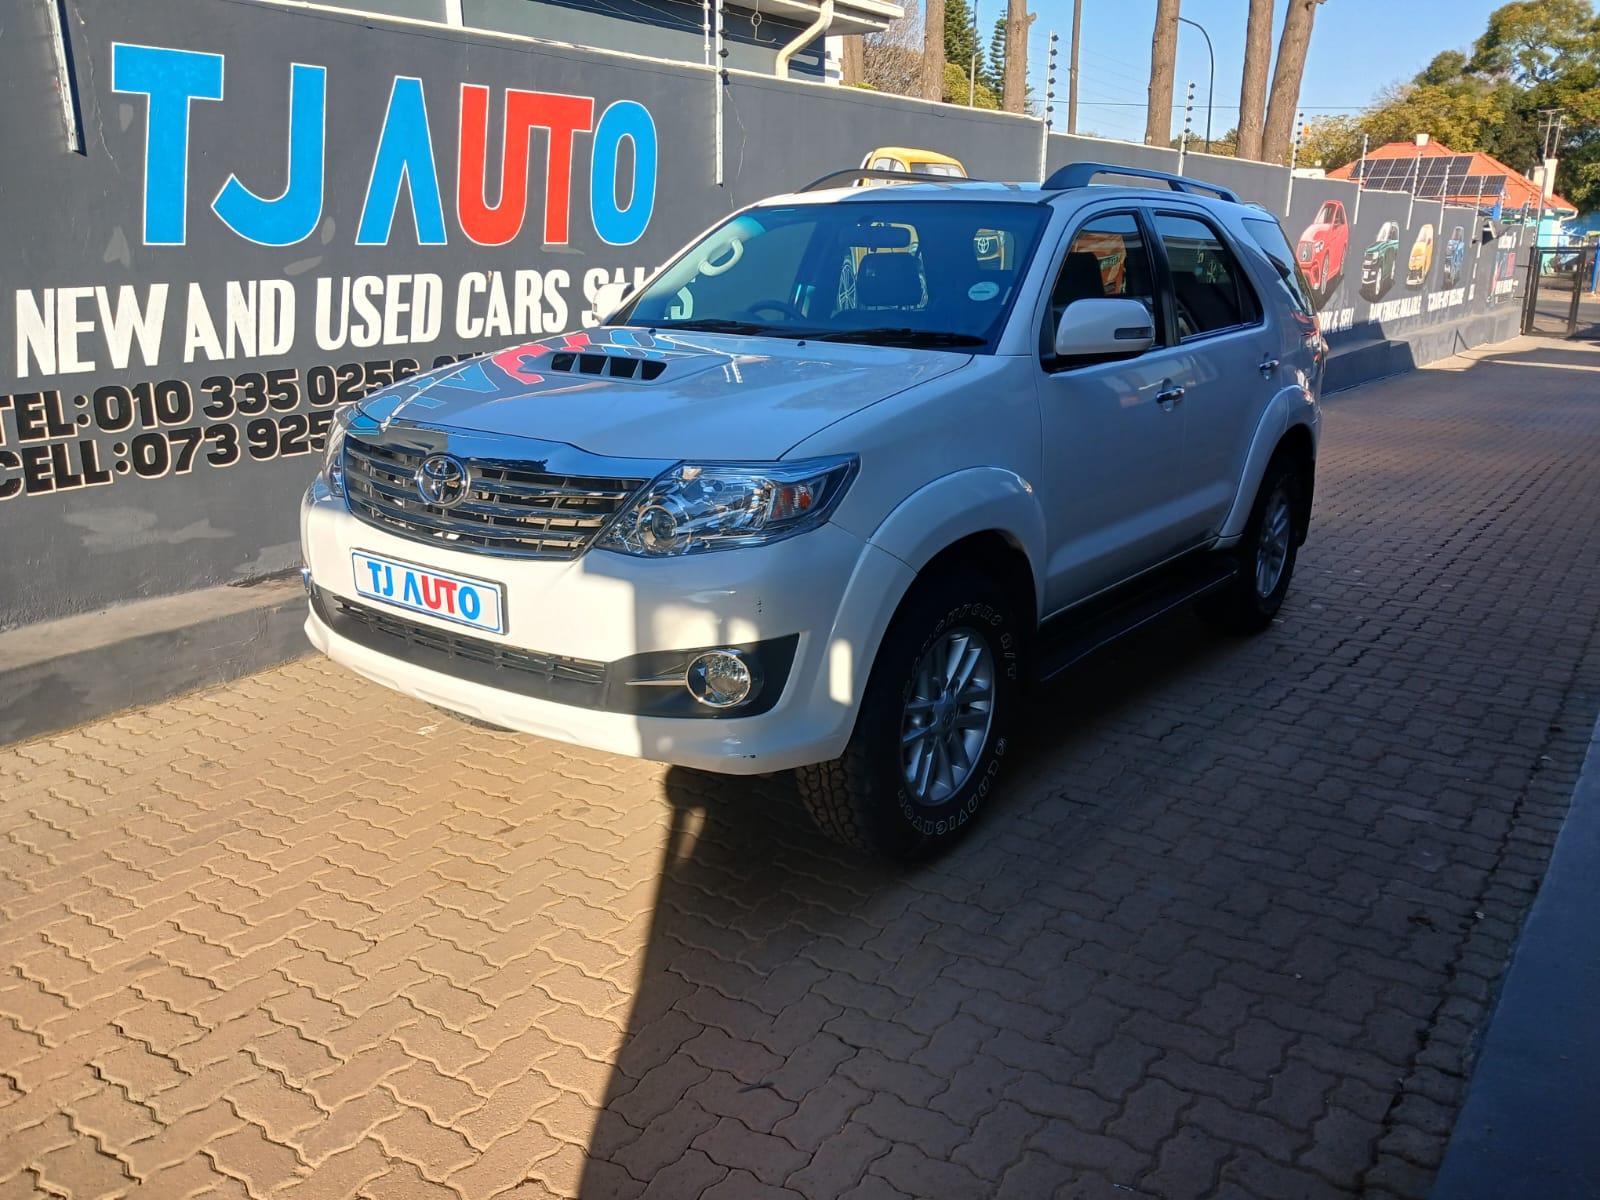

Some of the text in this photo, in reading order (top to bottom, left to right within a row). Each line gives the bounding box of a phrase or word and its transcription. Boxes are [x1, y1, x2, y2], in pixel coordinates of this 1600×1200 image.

[111, 42, 658, 247] TJ AUTO
[16, 283, 169, 378] NEW
[183, 279, 296, 363] AND
[315, 273, 443, 350] USED
[455, 269, 571, 339] CARS
[200, 368, 300, 422] 335
[367, 561, 481, 620] TJ AUTO
